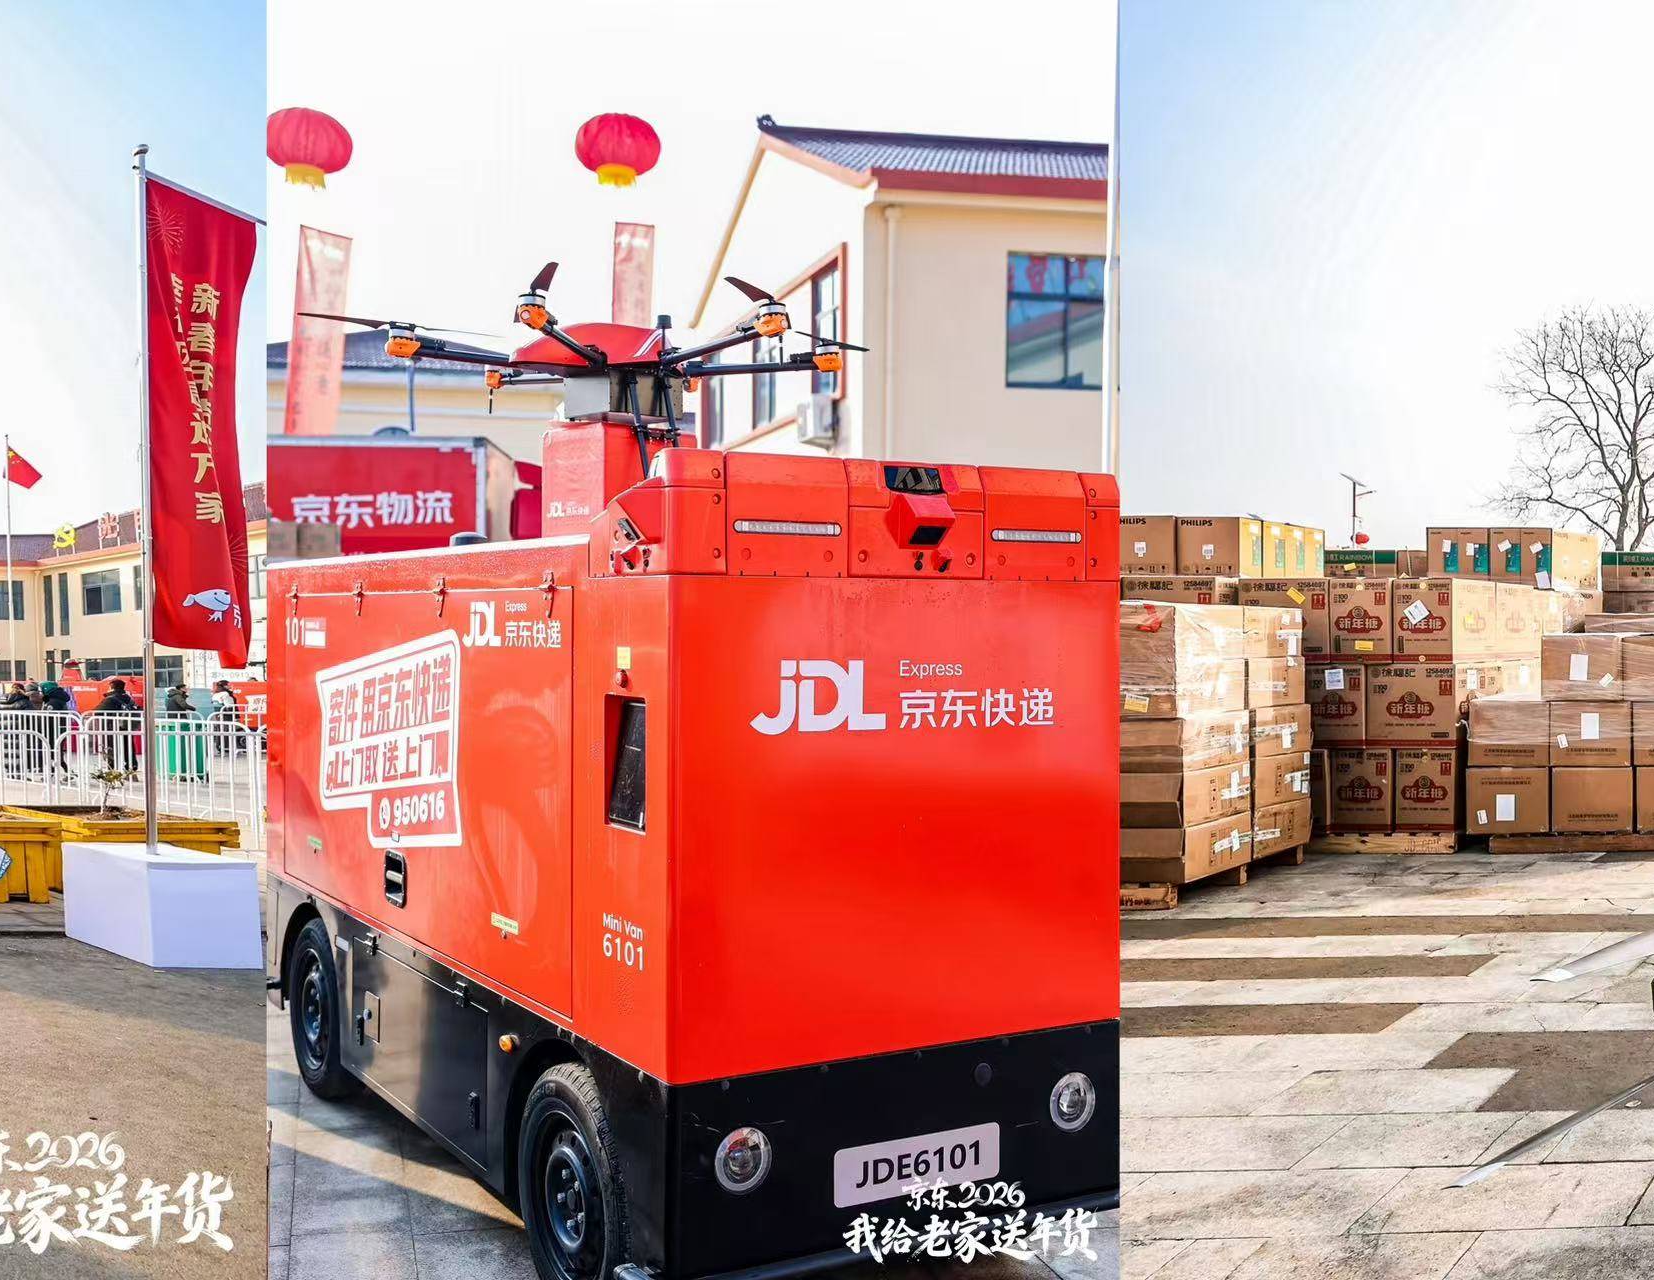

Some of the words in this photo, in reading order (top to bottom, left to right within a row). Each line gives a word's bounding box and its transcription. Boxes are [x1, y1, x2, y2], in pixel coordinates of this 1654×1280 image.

[291, 490, 454, 528] 京东物流
[1181, 519, 1213, 527] PHILIPS
[462, 601, 501, 648] JDL
[505, 600, 528, 613] Express
[504, 620, 562, 648] 京东快递
[1338, 617, 1378, 629] 新年糖
[749, 659, 887, 735] JDL
[899, 660, 963, 678] Express
[899, 688, 1054, 728] 京东快递
[1390, 703, 1430, 714] 新年糖
[393, 790, 446, 827] 950616
[1404, 788, 1443, 799] 新年糖
[602, 912, 622, 933] Mini
[624, 920, 644, 941] Van
[603, 933, 644, 971] 6101
[855, 1139, 981, 1189] JDE6101
